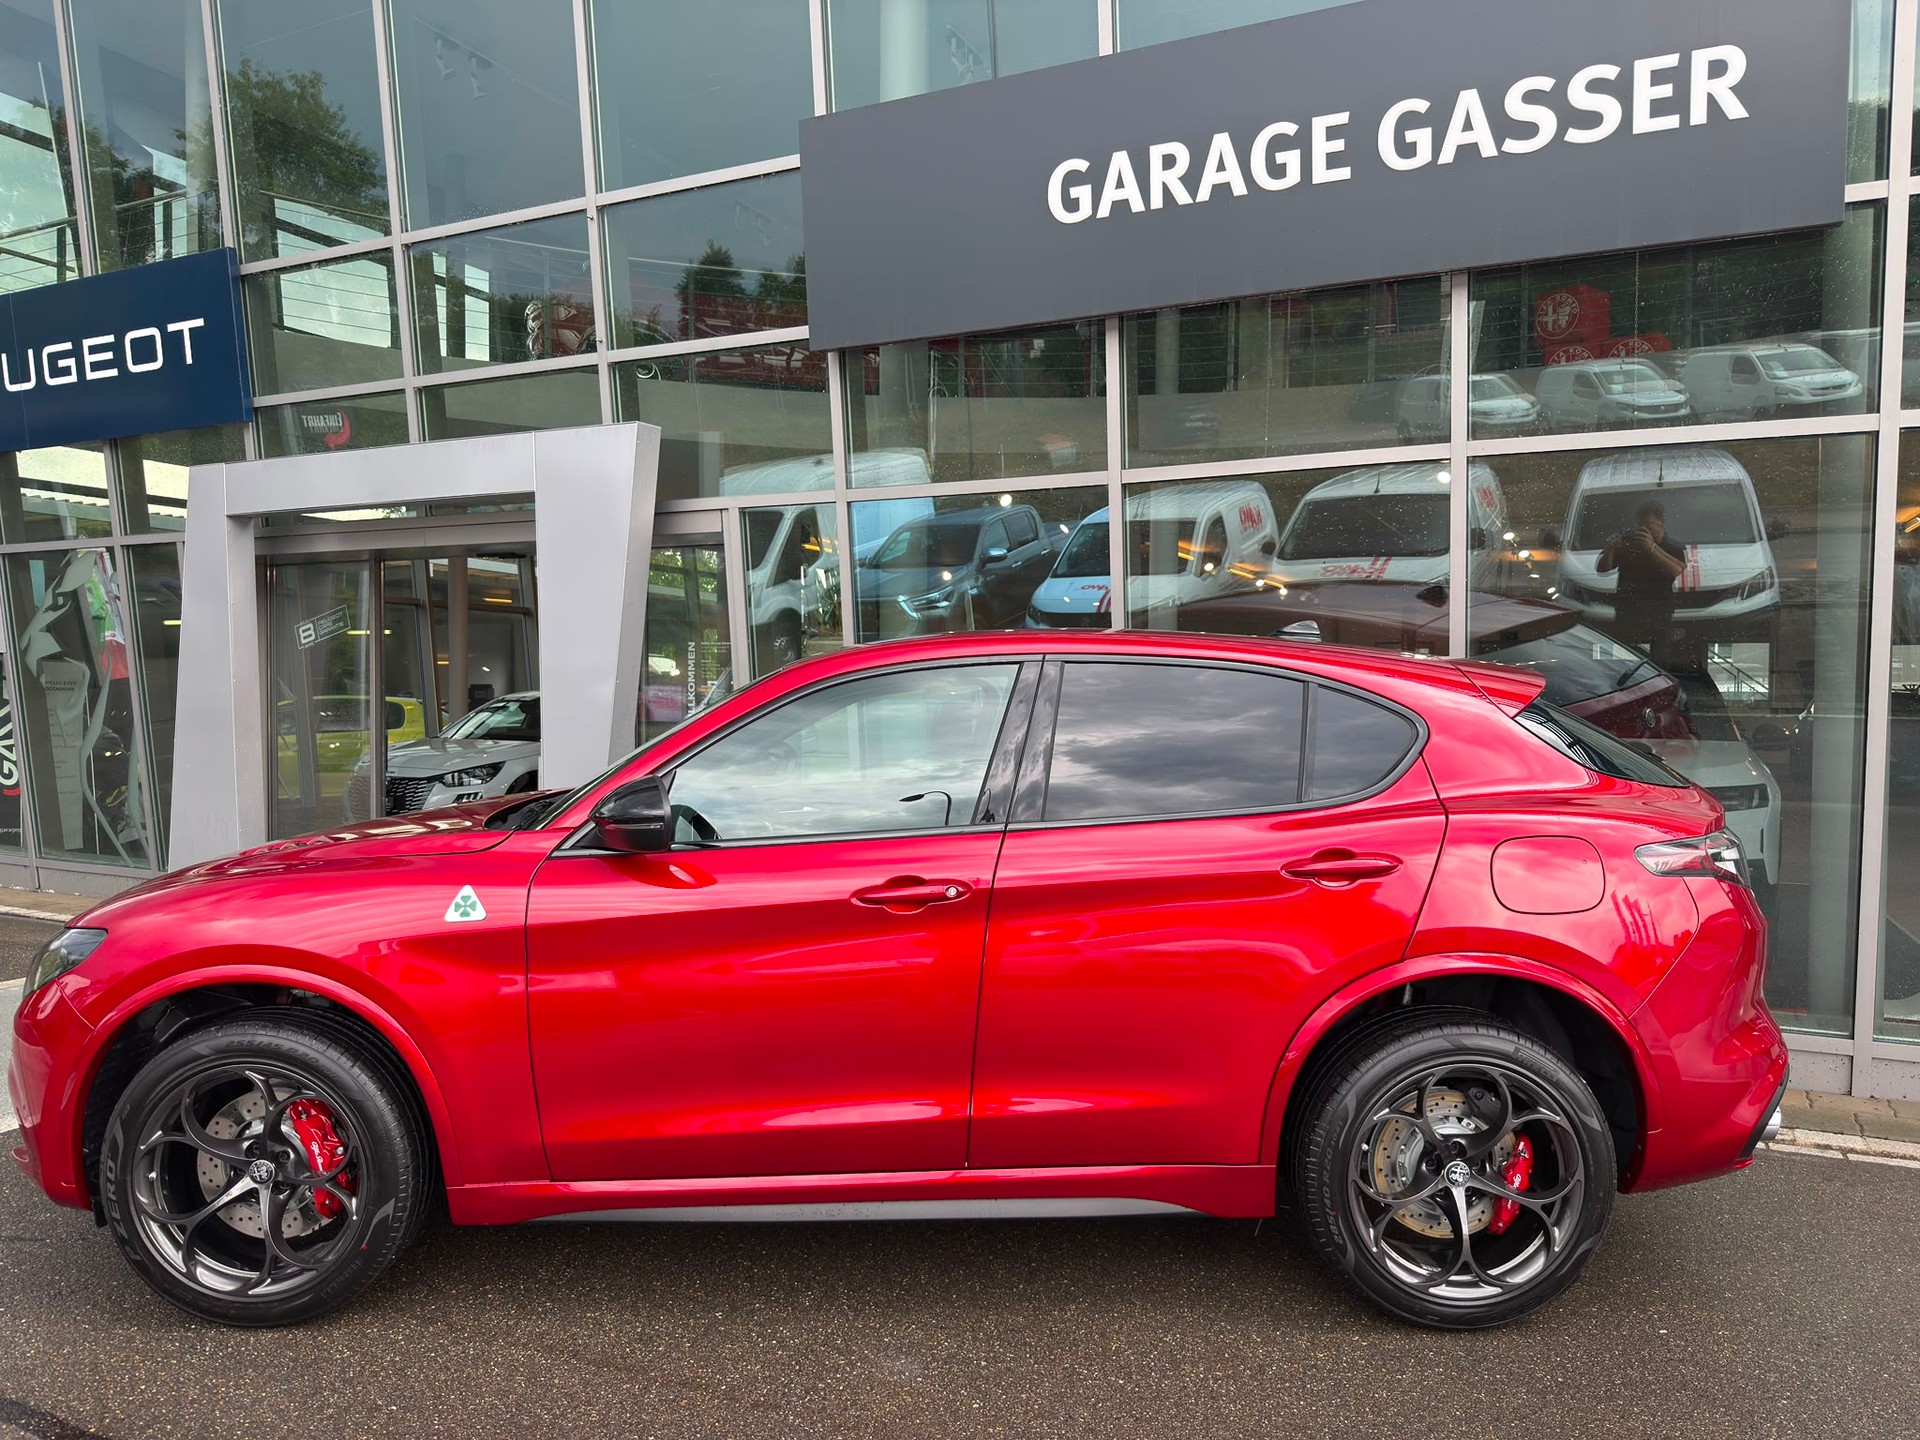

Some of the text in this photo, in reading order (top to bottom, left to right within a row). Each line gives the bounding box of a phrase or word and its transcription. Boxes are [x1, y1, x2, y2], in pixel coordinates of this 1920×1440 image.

[1047, 44, 1750, 225] GARAGE GASSER
[1, 317, 205, 392] UGEOT
[299, 622, 316, 644] 8
[106, 1158, 129, 1240] ZERO
